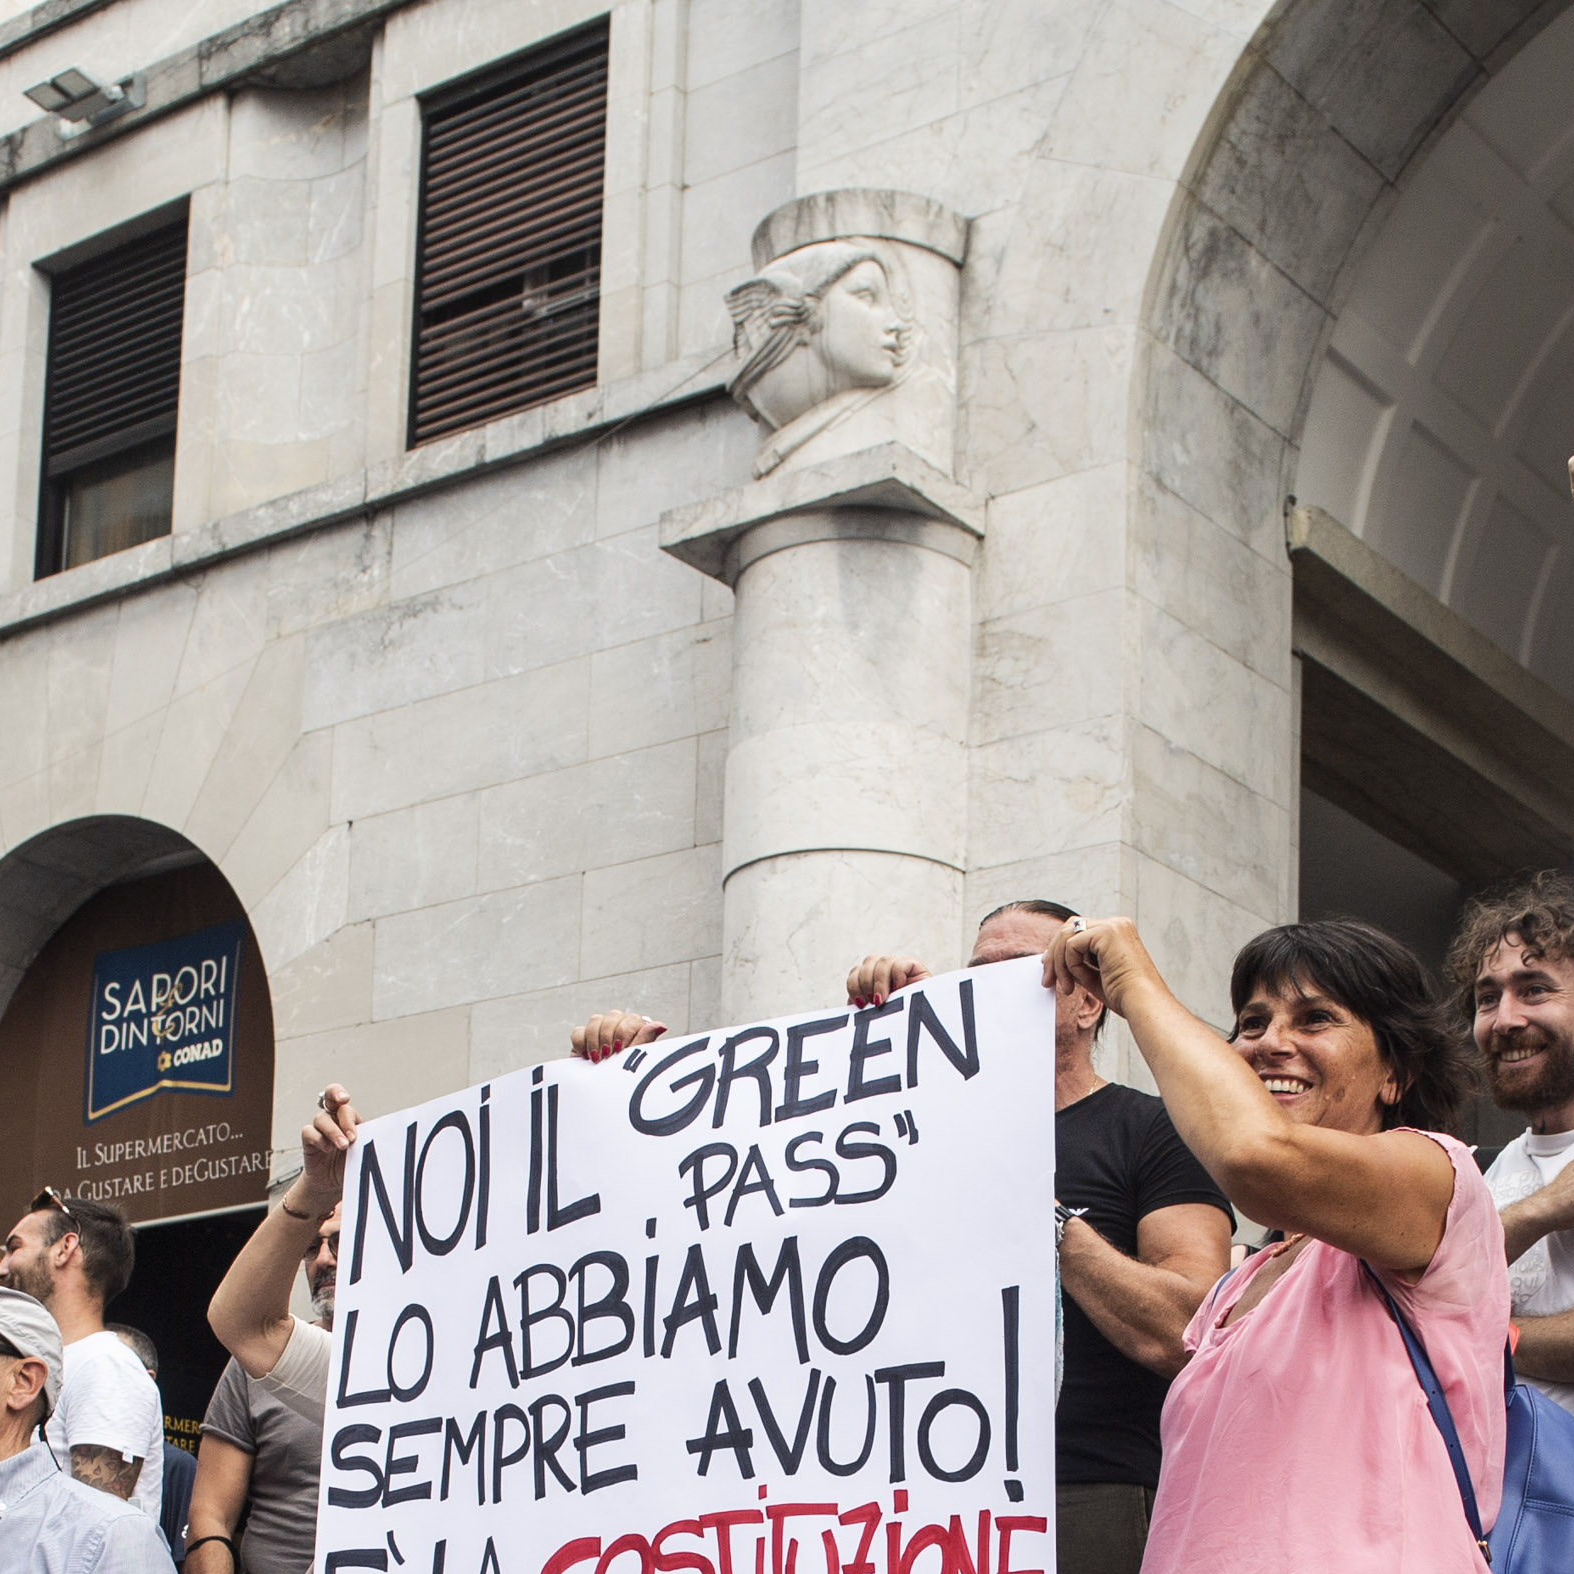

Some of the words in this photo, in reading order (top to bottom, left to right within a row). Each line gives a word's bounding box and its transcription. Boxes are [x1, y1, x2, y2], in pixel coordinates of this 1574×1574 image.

[100, 998, 224, 1054] DINTORNI
[101, 955, 227, 1021] SAPORI
[173, 1038, 223, 1067] CONAD
[349, 1083, 491, 1286] NOI
[527, 1065, 601, 1235] IL
[622, 978, 980, 1137] "GREEN
[678, 1109, 919, 1232] PASS"
[336, 1303, 435, 1409] LO
[469, 1217, 890, 1390] ABBIAMO
[327, 1380, 638, 1509] SEMPRE
[686, 1285, 1025, 1503] AVUTO!
